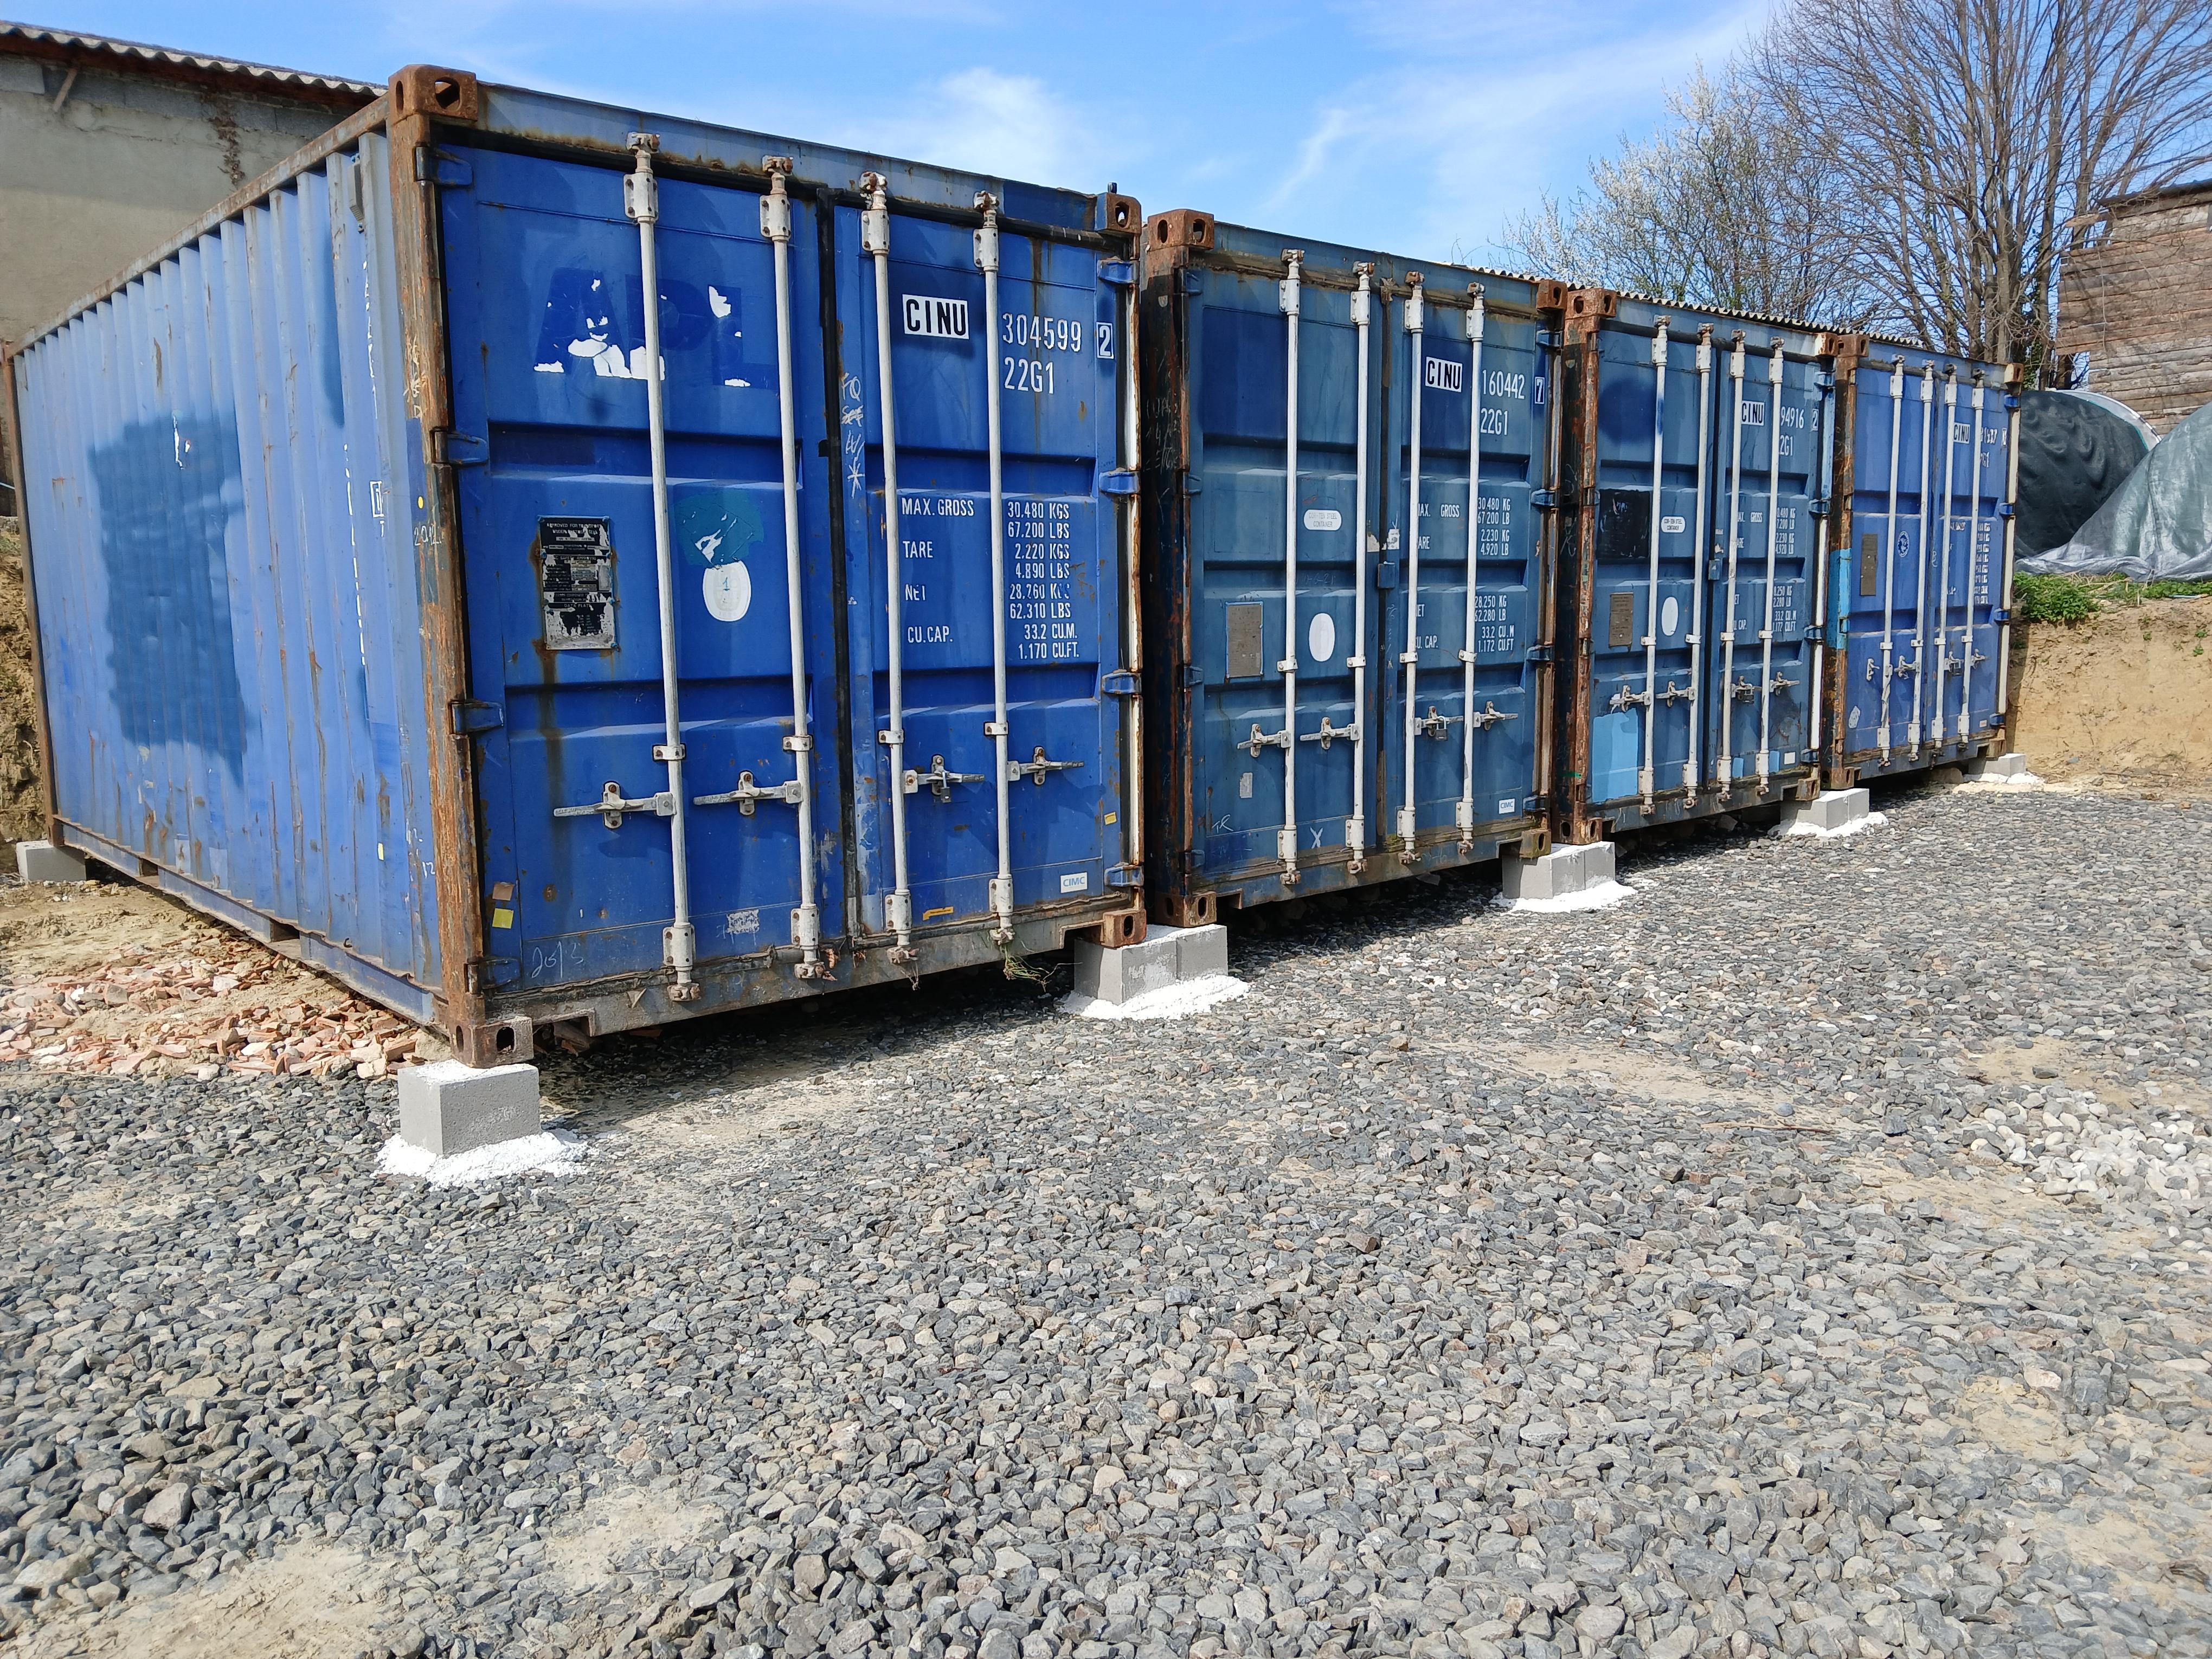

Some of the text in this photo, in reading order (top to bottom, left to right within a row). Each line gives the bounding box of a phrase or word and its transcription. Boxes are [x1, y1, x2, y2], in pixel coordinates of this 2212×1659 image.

[906, 299, 1111, 357] CINU 304599 2
[1005, 357, 1053, 394] 22G1
[1427, 360, 1543, 402] CINU 160442 7
[1481, 408, 1508, 435] 22G1
[1742, 403, 1763, 423] CINU
[1954, 425, 1970, 442] CINU
[1779, 435, 1793, 455] 2G1
[902, 498, 935, 515] MAX.
[938, 499, 974, 516] GROSS
[1050, 503, 1069, 519] KGS
[1441, 504, 1460, 517] GROSS
[1502, 498, 1510, 511] KG
[1502, 512, 1510, 525] LB
[1050, 523, 1069, 538] LBS
[1418, 536, 1430, 549] ARE
[1501, 529, 1510, 542] KG
[903, 541, 933, 558] TARE
[1050, 543, 1069, 559] KGS
[1501, 543, 1509, 556] LB
[1050, 563, 1070, 578] LBS
[1051, 602, 1071, 618] LBS
[1416, 604, 1425, 617] ET
[1499, 595, 1507, 607] KG
[1499, 608, 1506, 621] LB
[1024, 623, 1046, 640] 33.2
[1052, 623, 1078, 639] CU.M.
[1052, 641, 1079, 658] CU.FT.
[1425, 635, 1438, 648] CAP.
[1063, 876, 1085, 887] CIMC
